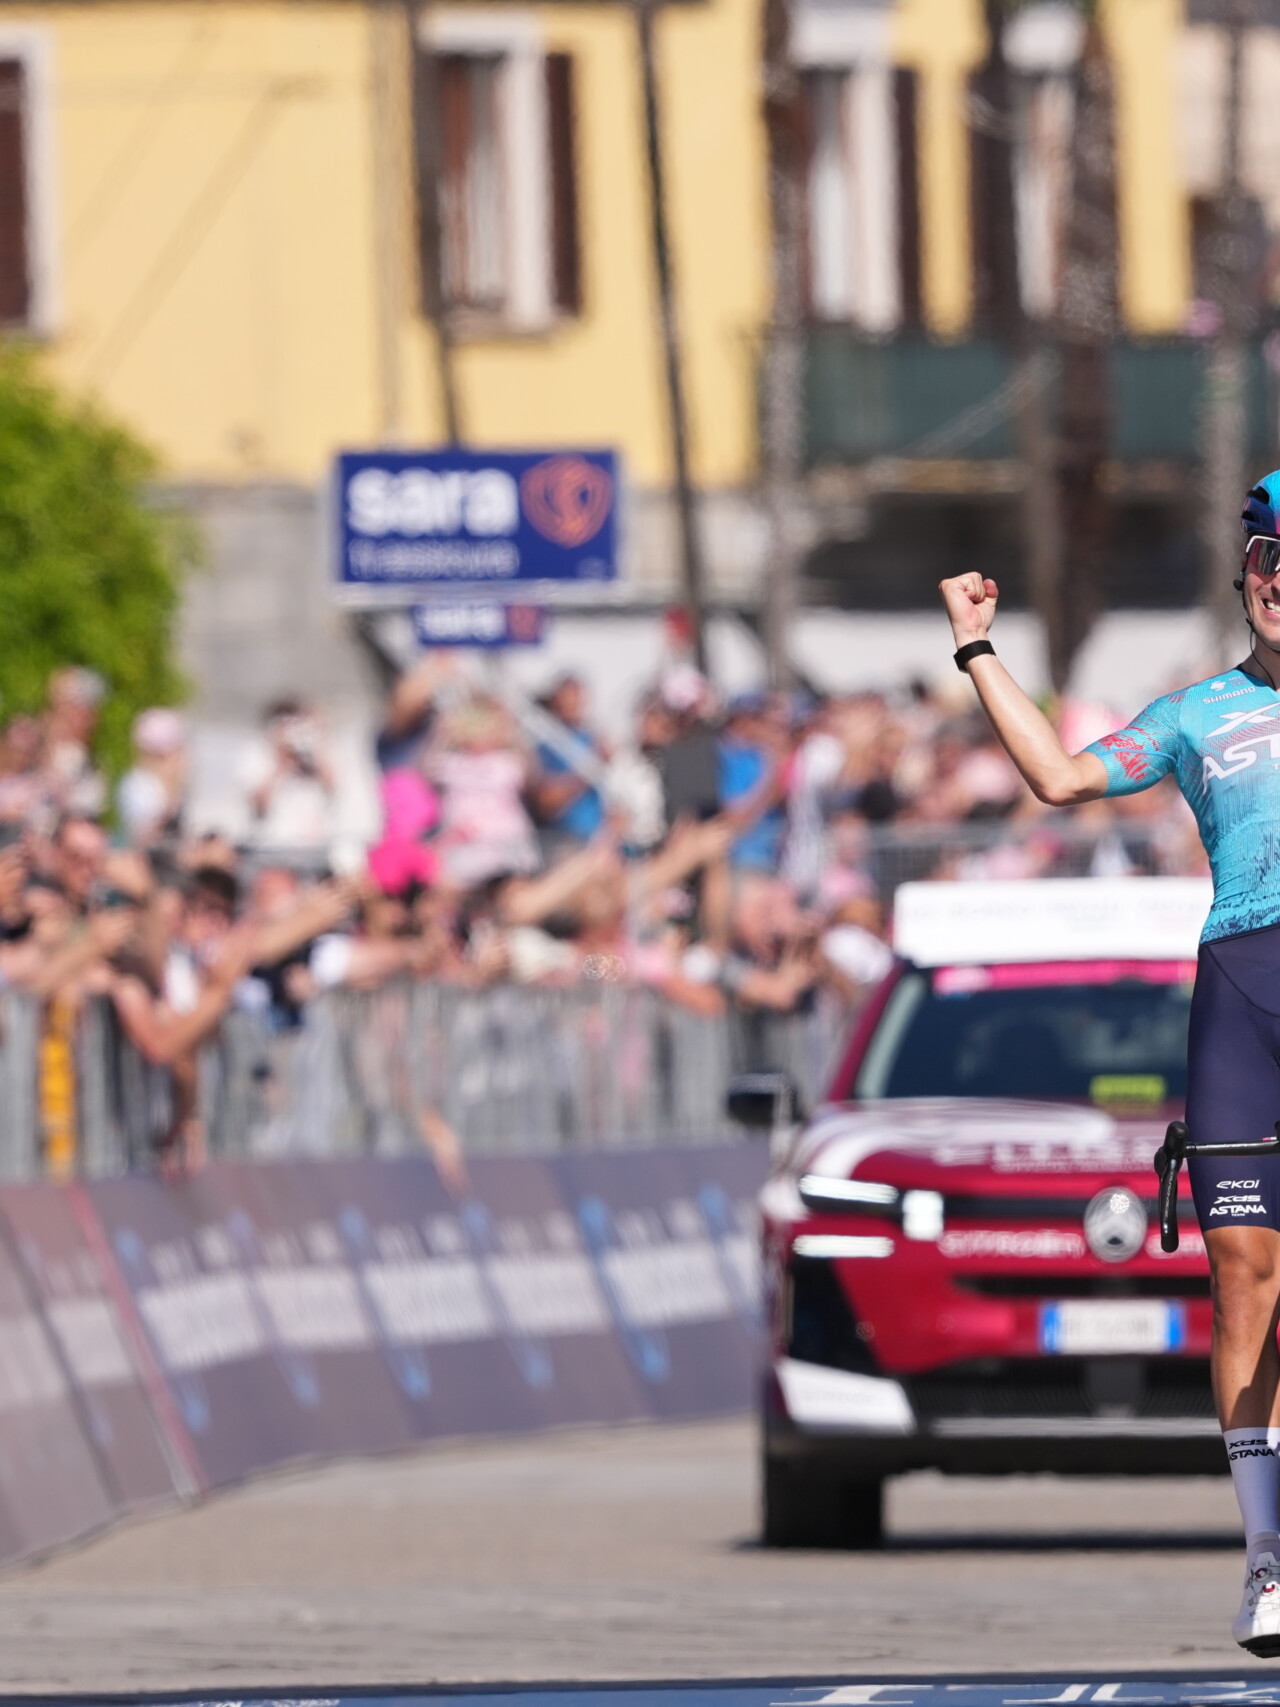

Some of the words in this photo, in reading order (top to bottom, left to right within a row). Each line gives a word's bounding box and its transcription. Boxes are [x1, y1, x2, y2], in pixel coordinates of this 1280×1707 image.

[348, 467, 520, 538] sara
[1203, 686, 1256, 704] SHIMANO
[1209, 1205, 1267, 1217] ASTANA
